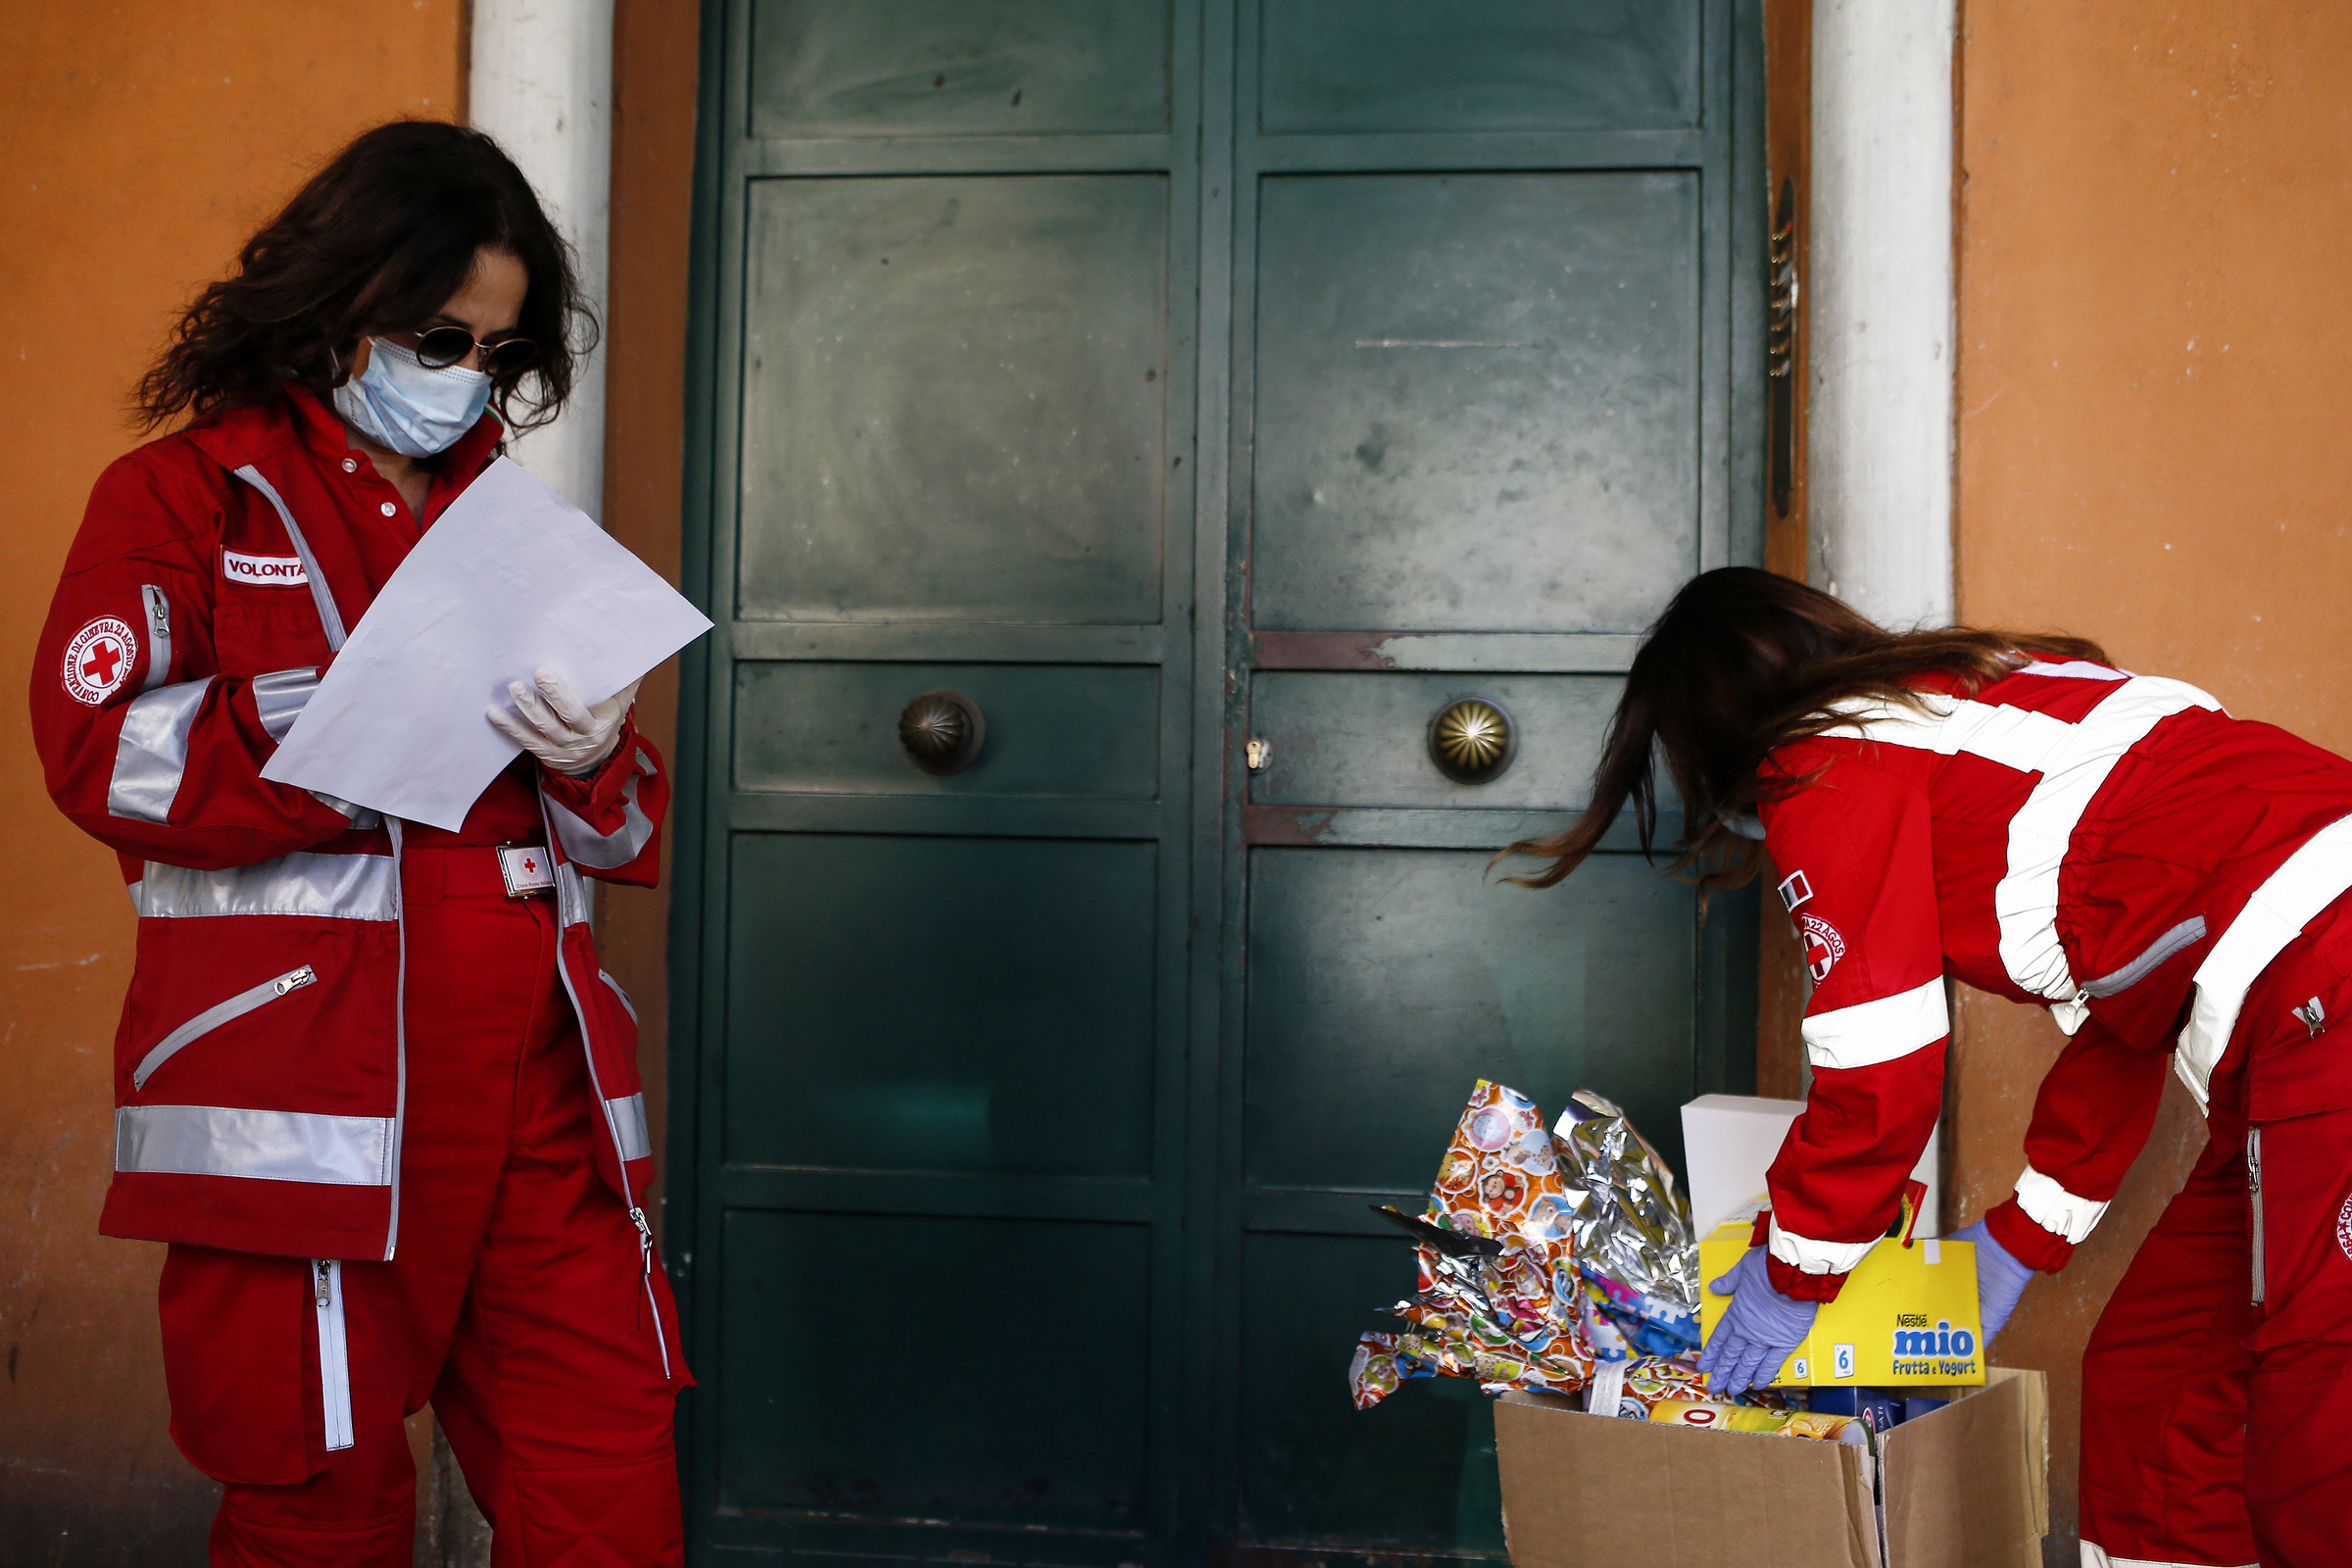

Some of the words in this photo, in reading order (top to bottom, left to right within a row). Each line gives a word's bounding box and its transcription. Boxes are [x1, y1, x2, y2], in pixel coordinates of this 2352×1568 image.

[114, 623, 124, 637] 22
[1810, 920, 1823, 933] 22
[1893, 1321, 1974, 1356] mio
[1838, 1349, 1849, 1370] 6
[1797, 1362, 1804, 1374] 6
[1892, 1359, 1930, 1375] Frutta
[1938, 1360, 1976, 1377] Yogurt
